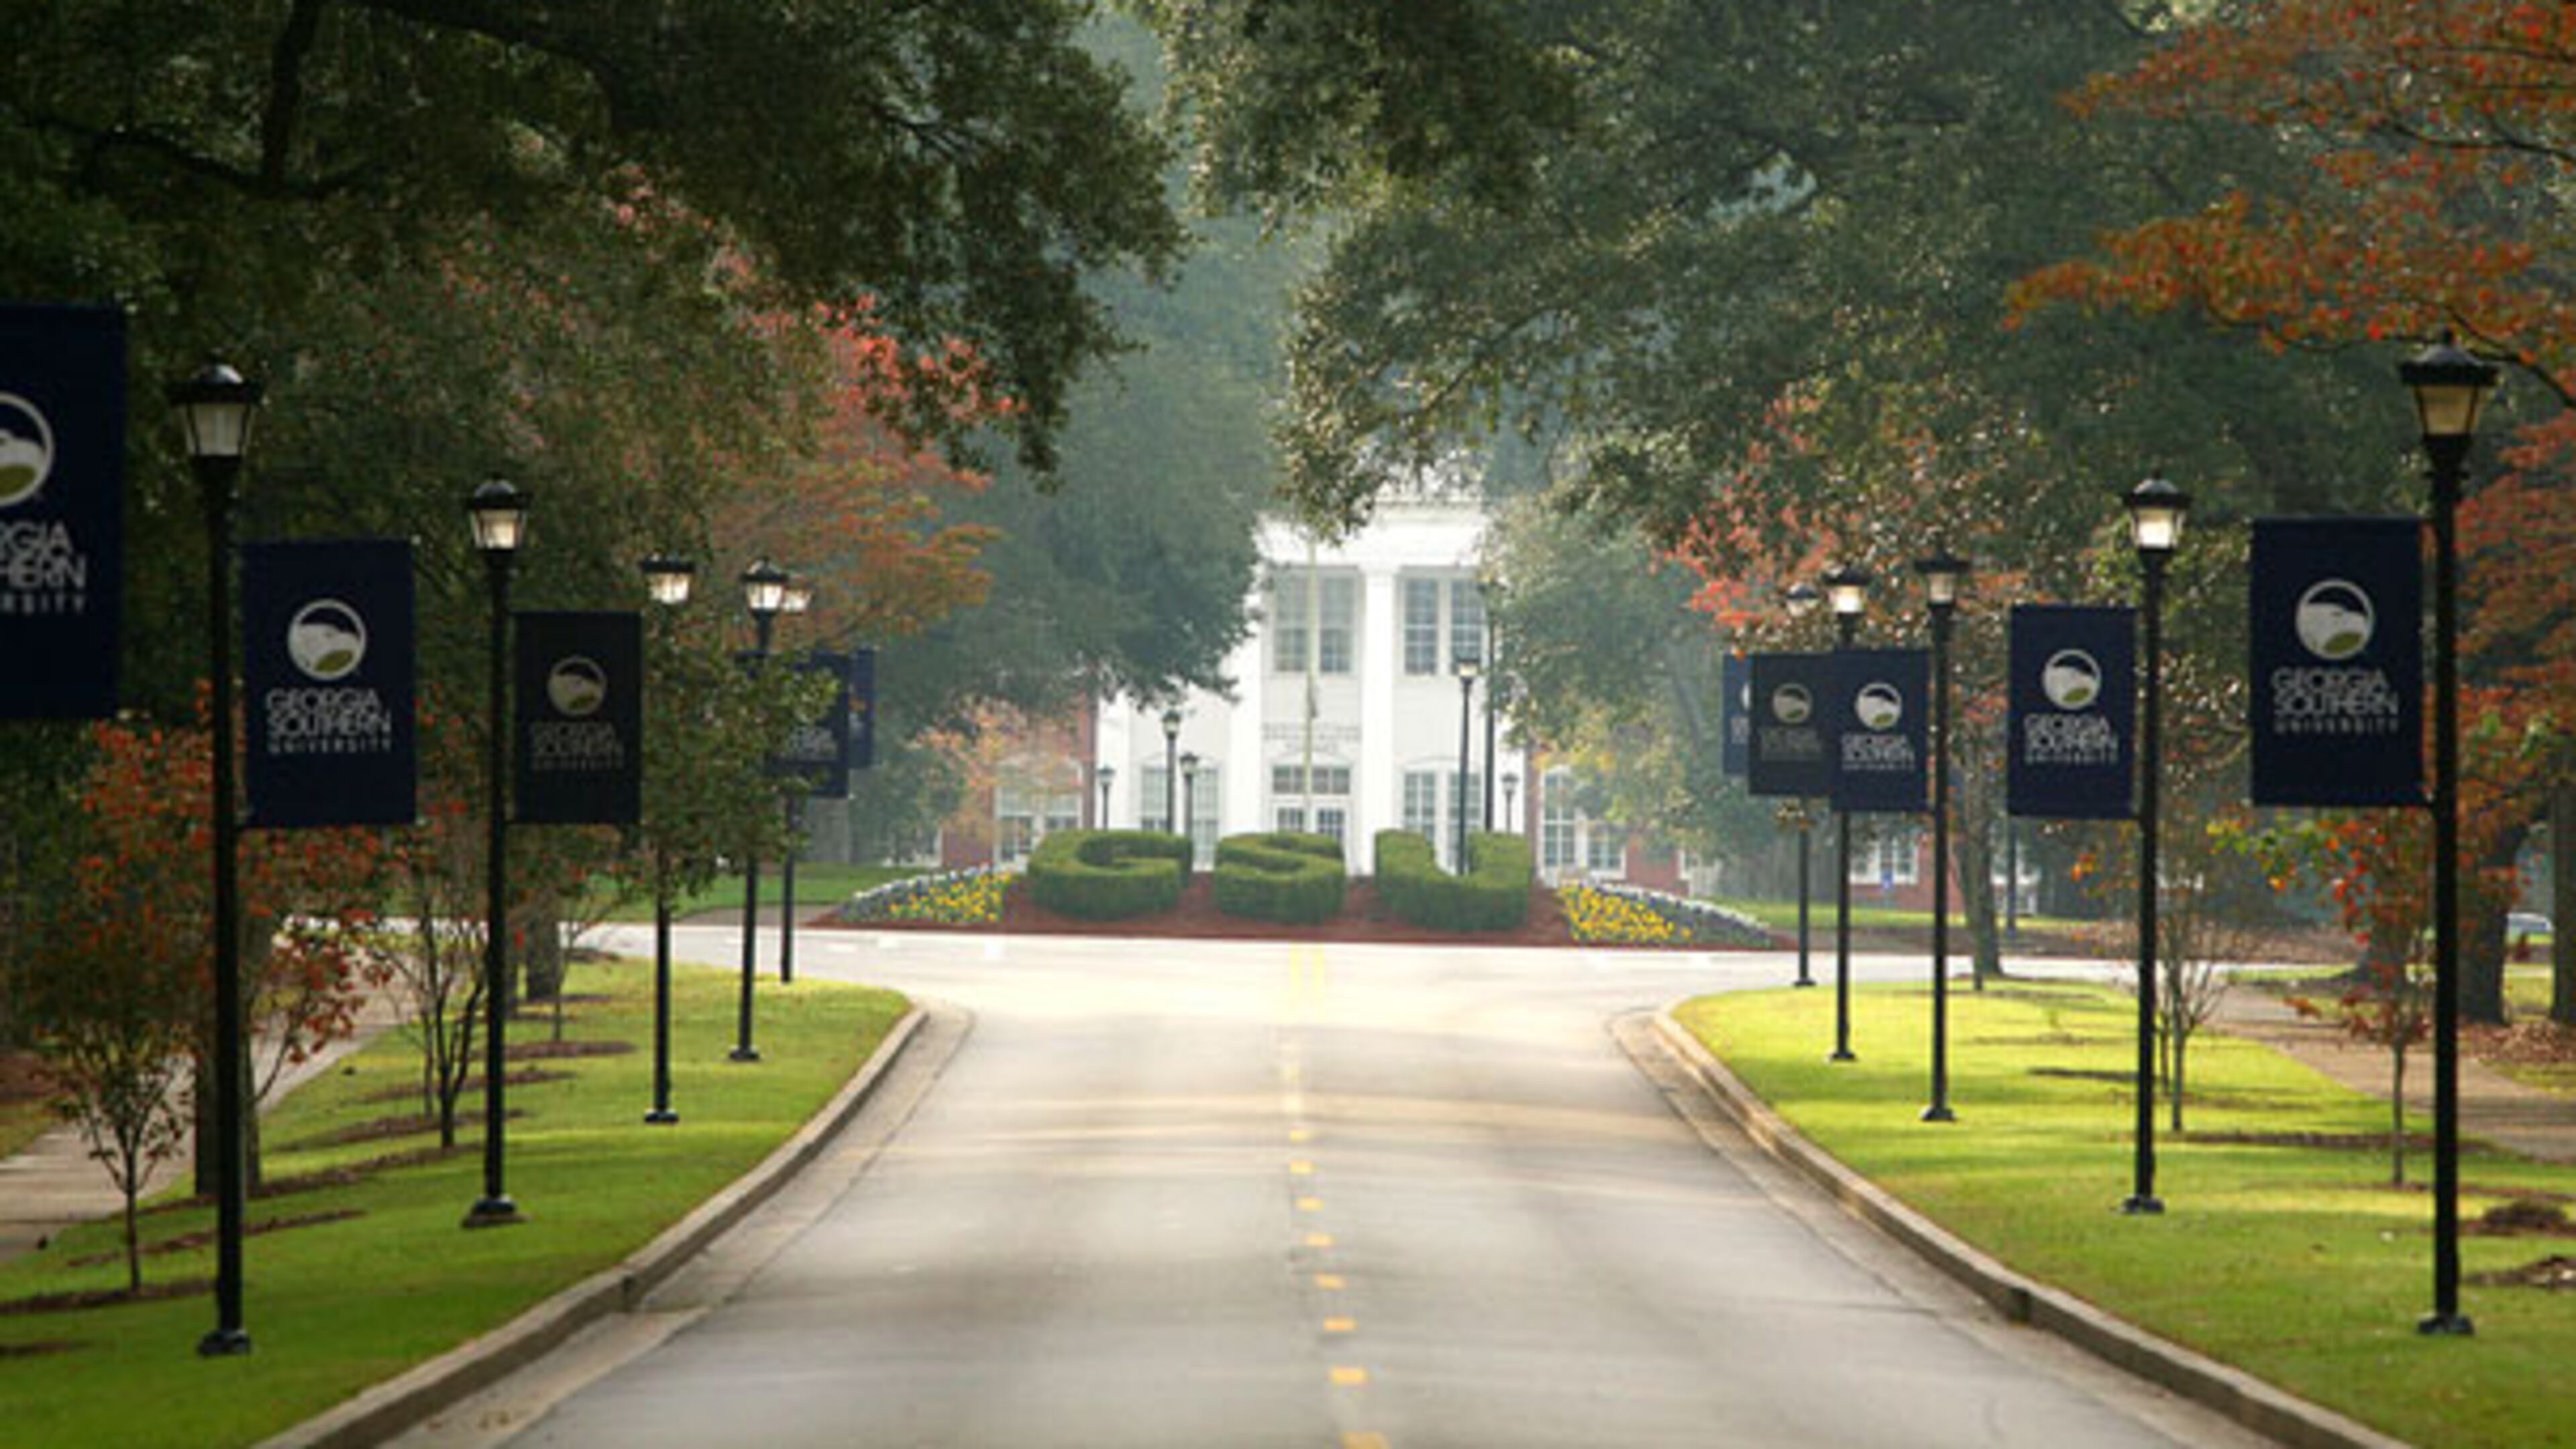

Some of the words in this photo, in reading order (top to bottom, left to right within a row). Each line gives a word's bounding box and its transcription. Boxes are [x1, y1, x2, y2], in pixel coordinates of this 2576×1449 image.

[2271, 666, 2389, 690] GEORGIA
[266, 687, 382, 712] GEORGIA
[2274, 688, 2399, 715] SOUTHERN
[268, 709, 390, 736] SOUTHERN
[2023, 713, 2110, 733] GEORGIA
[2026, 731, 2118, 751] SOUTHERN
